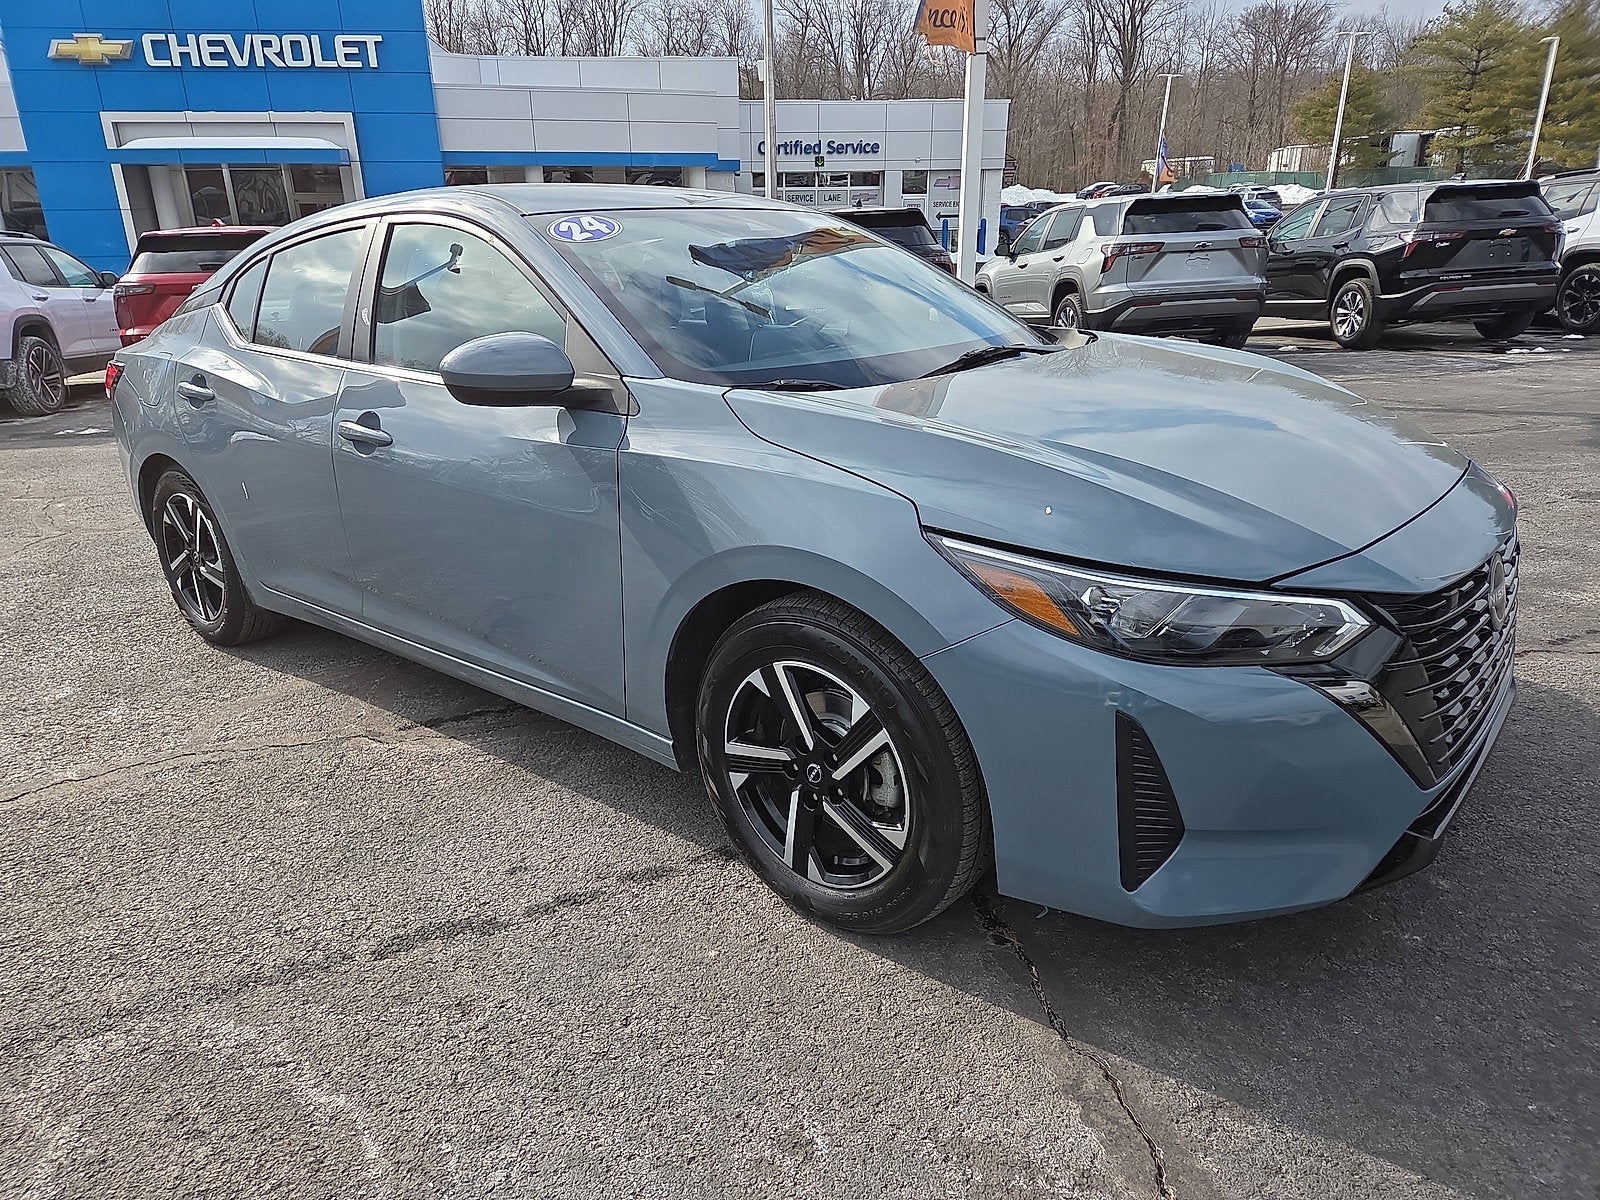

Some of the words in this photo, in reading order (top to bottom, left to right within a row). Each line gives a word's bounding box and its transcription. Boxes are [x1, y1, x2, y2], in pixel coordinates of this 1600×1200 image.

[141, 33, 383, 68] CHEVROLET
[757, 139, 822, 155] Crtified
[826, 139, 881, 155] Service
[787, 193, 814, 203] SERVICE
[823, 193, 842, 202] LANE
[932, 200, 952, 208] SERVICE
[558, 216, 613, 241] 24
